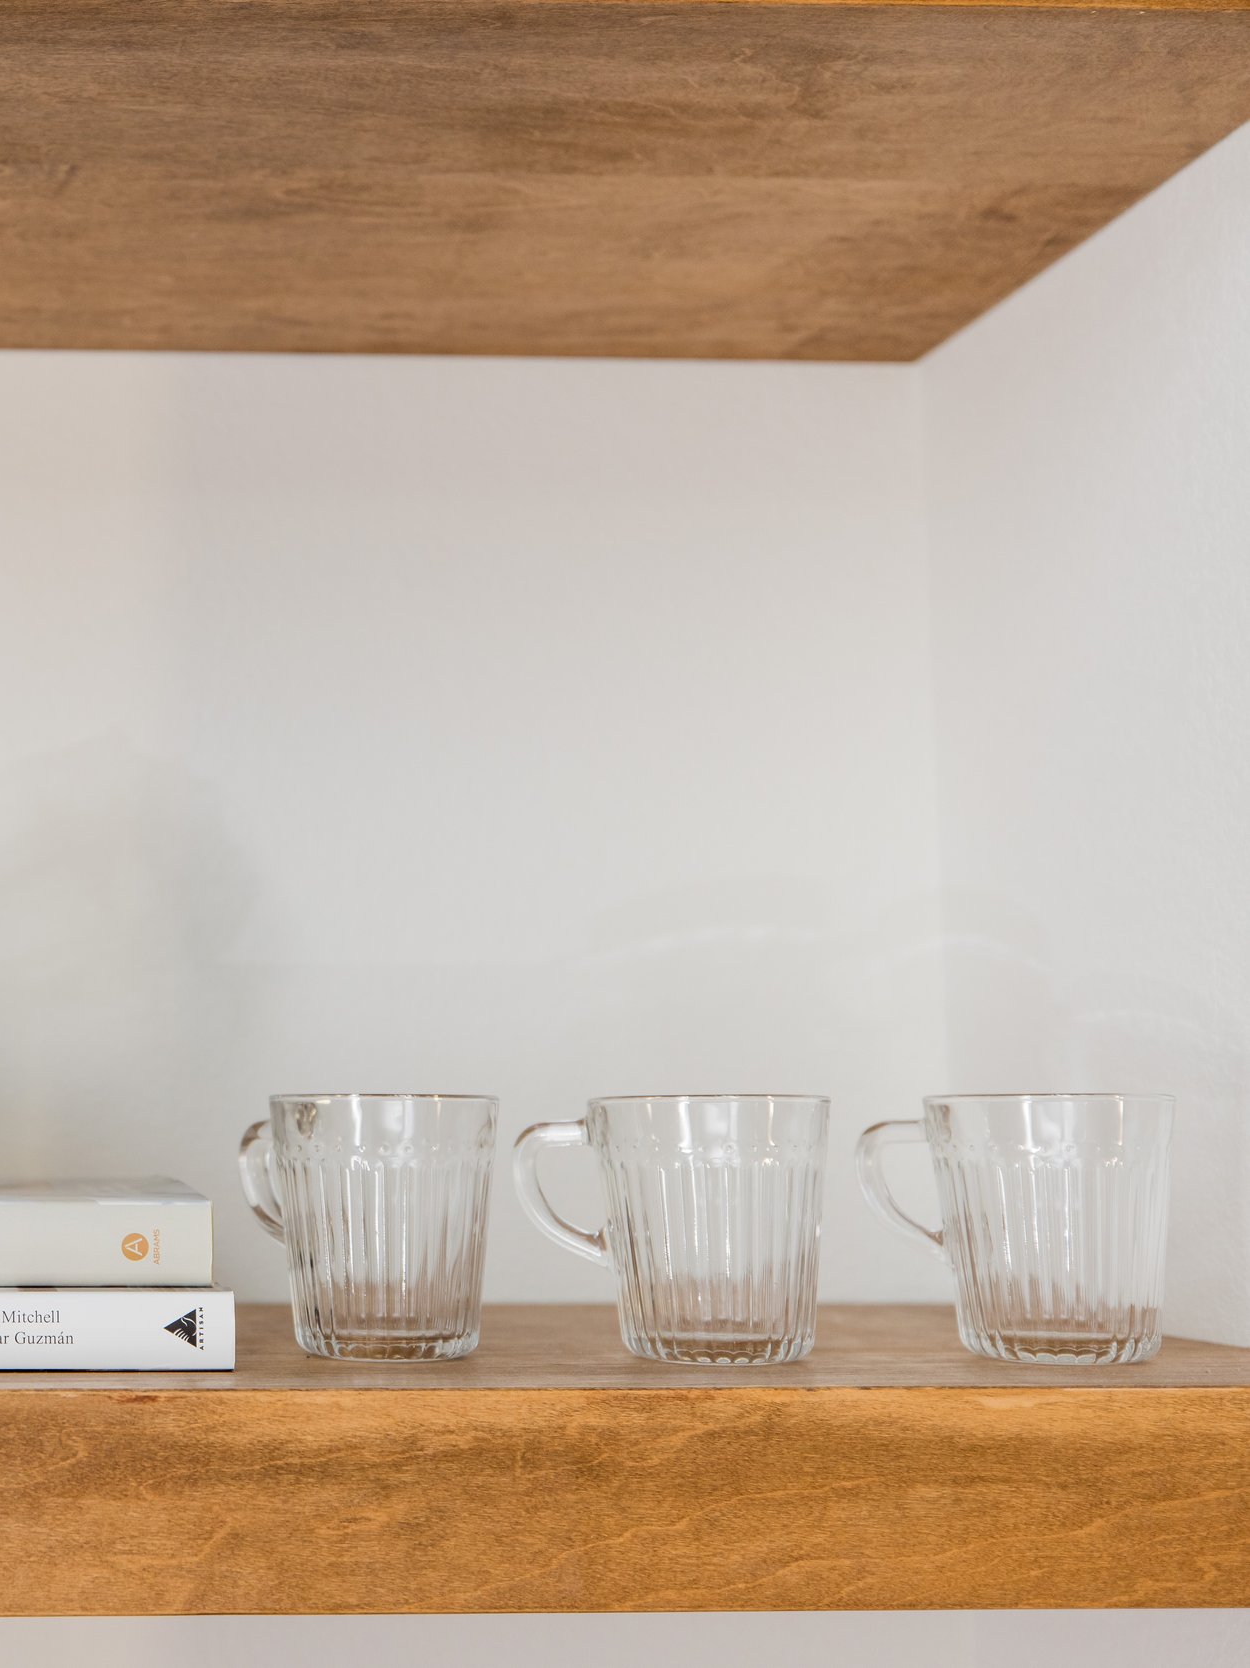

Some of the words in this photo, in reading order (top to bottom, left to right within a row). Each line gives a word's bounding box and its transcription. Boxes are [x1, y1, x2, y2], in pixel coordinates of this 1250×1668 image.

[153, 1228, 161, 1265] ABRAMS
[2, 1310, 60, 1324] Mitchell
[15, 1331, 74, 1345] Guzmán
